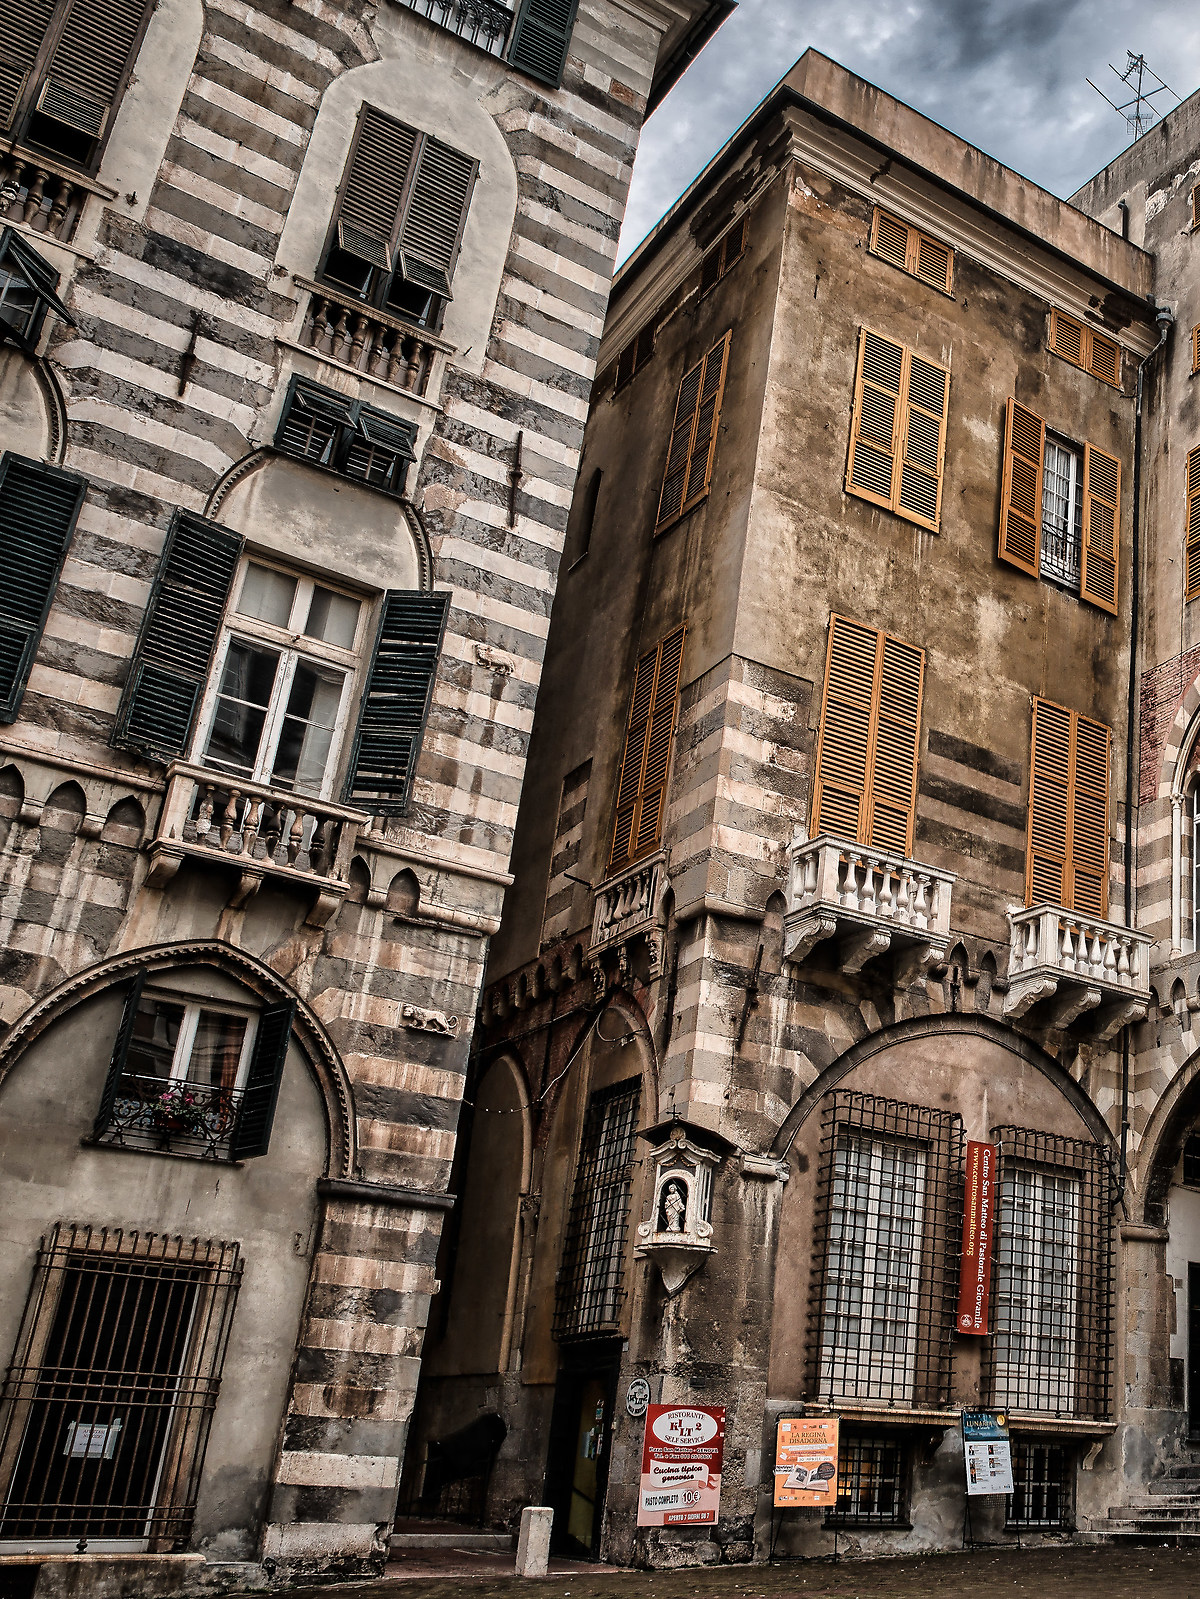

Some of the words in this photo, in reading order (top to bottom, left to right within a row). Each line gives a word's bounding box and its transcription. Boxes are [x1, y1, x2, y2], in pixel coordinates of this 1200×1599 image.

[983, 1149, 991, 1178] Centro
[982, 1180, 990, 1196] San
[966, 1147, 979, 1256] www.centrosanmatteo.org
[980, 1198, 989, 1229] Matteo
[980, 1230, 988, 1240] di
[977, 1242, 987, 1283] Pastorale
[974, 1284, 985, 1329] Giovanile
[667, 1411, 706, 1421] RISTORANTE
[695, 1422, 702, 1431] 2
[664, 1434, 680, 1443] SELF
[680, 1435, 706, 1444] SERVICE
[653, 1465, 680, 1474] Cucina
[681, 1465, 703, 1475] tipica
[661, 1473, 695, 1484] genovese
[645, 1496, 658, 1507] PASTO
[658, 1494, 679, 1505] COMPLETO
[668, 1514, 684, 1522] APERTO
